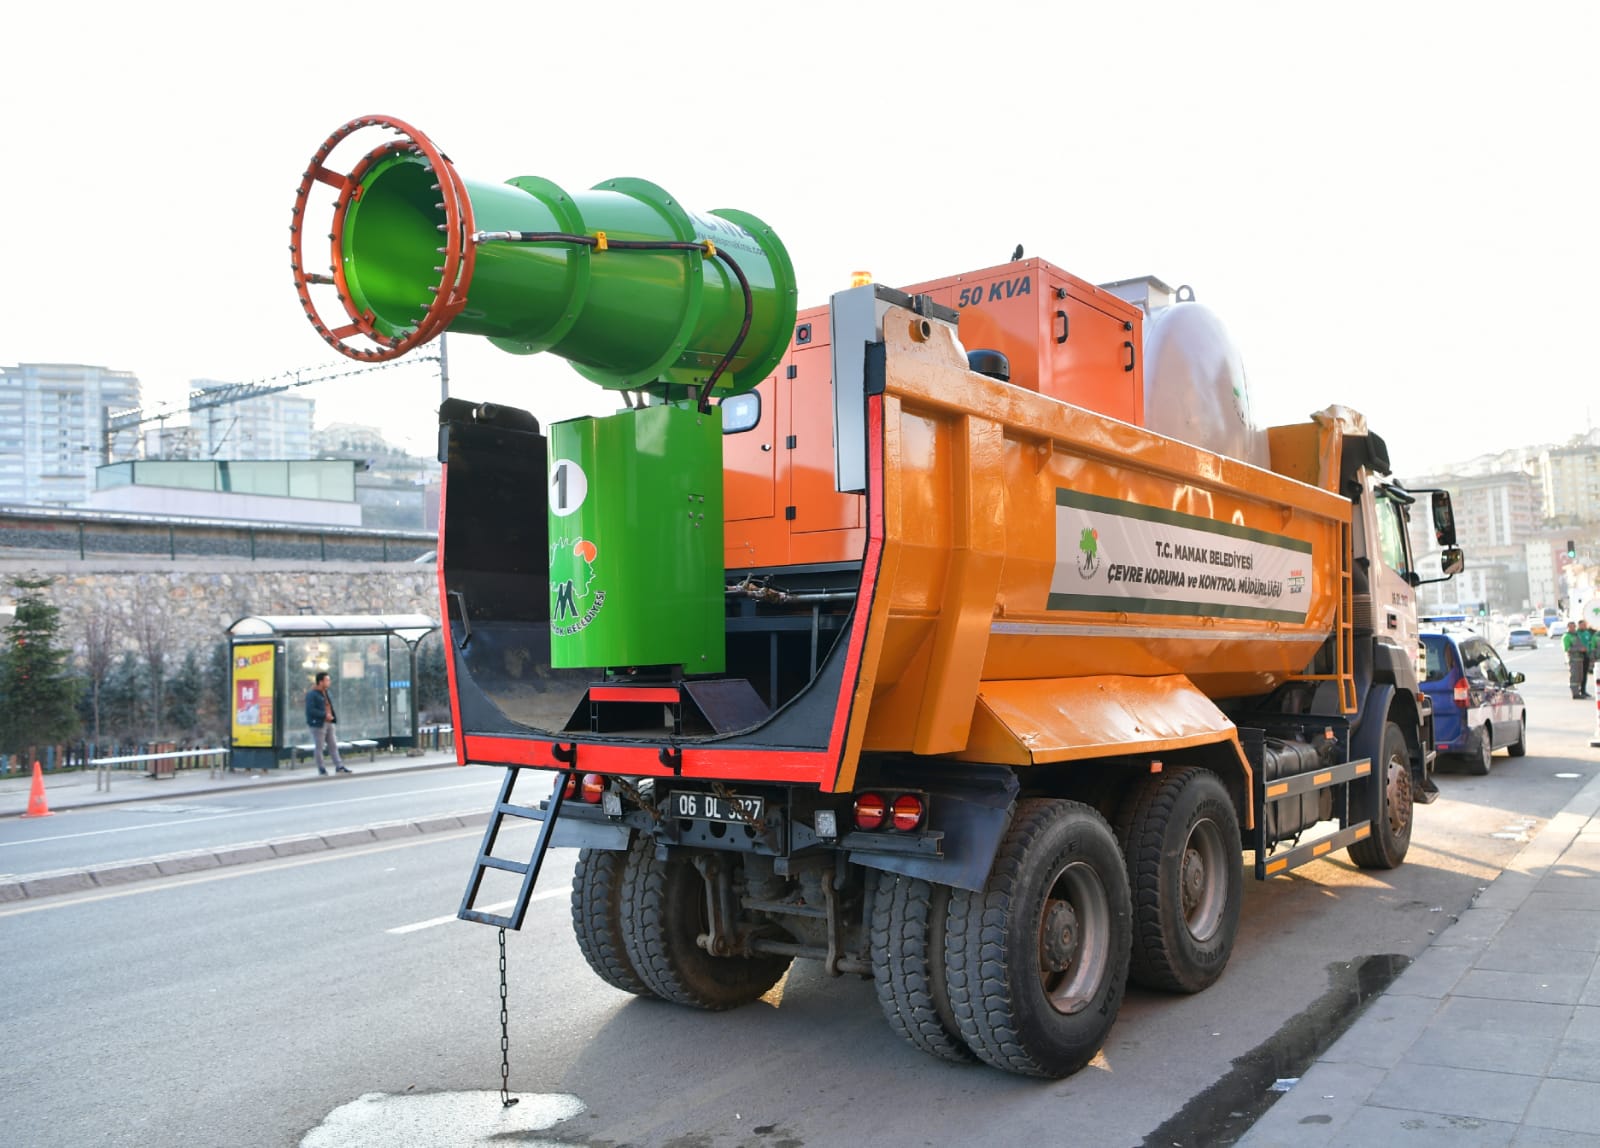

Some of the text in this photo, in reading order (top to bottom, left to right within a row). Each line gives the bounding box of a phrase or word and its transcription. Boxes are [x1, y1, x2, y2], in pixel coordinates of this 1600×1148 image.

[958, 275, 1031, 308] 50 KVA
[552, 464, 568, 510] 1
[1155, 541, 1254, 571] T.C. MAMAK BELEDİYESİ
[1107, 563, 1144, 584] ÇEVRE
[1144, 567, 1185, 588] KORUMA
[1187, 575, 1198, 589] ve
[1198, 574, 1237, 593] KONTROL
[1238, 576, 1283, 599] MÜDÜRLÜĞÜ
[566, 590, 606, 635] BELEDİYESİ
[680, 794, 697, 816] 06
[705, 796, 722, 819] DL
